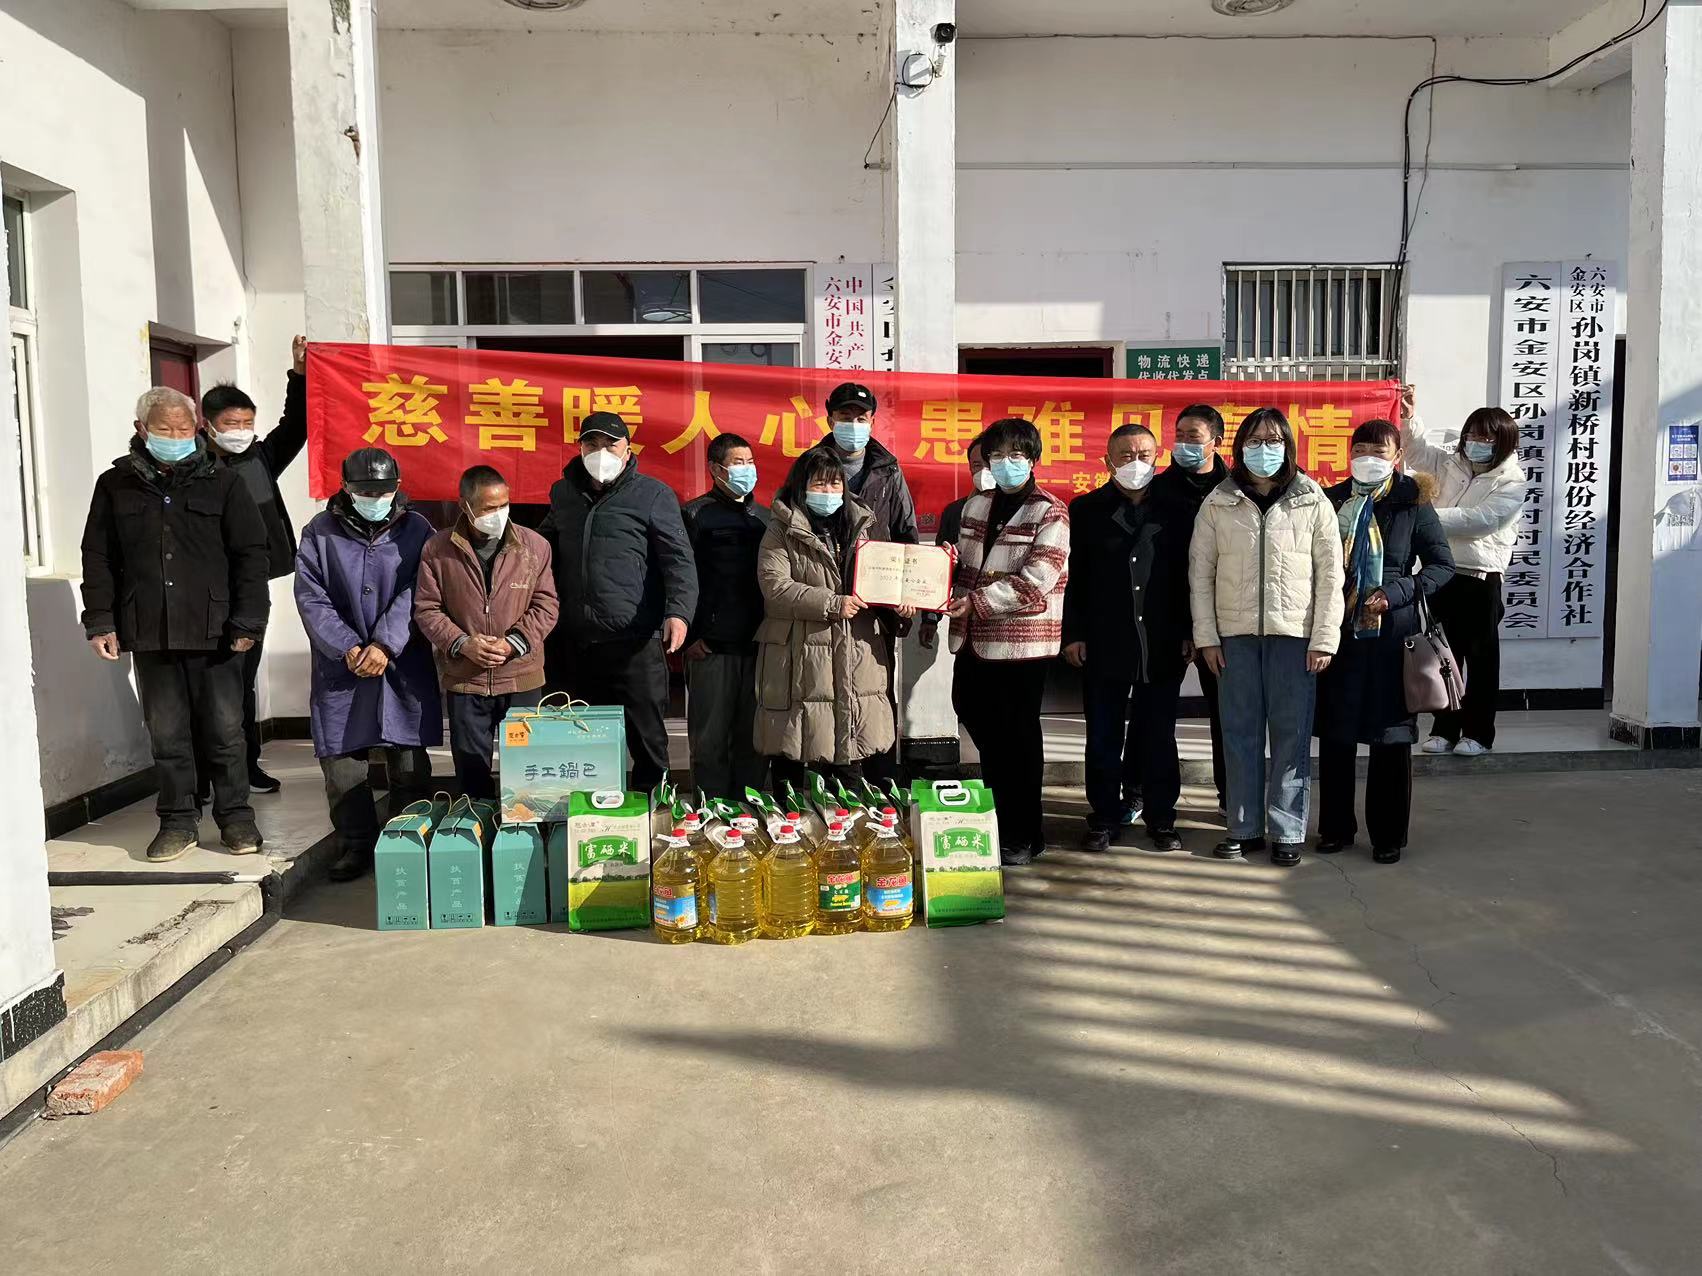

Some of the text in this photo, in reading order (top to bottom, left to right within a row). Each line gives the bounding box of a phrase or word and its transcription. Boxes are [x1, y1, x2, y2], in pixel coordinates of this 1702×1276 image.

[1569, 266, 1587, 313] 金安区
[1590, 266, 1607, 313] 六安市
[824, 276, 842, 369] 六安市金安
[846, 276, 864, 370] 中国共产
[1137, 353, 1210, 369] 物流快递
[361, 373, 833, 457] 慈善暖人心
[1560, 316, 1604, 626] 孙岗镇新桥村股份经济合作社
[584, 841, 631, 859] 富硒米
[940, 834, 984, 850] 富硒米
